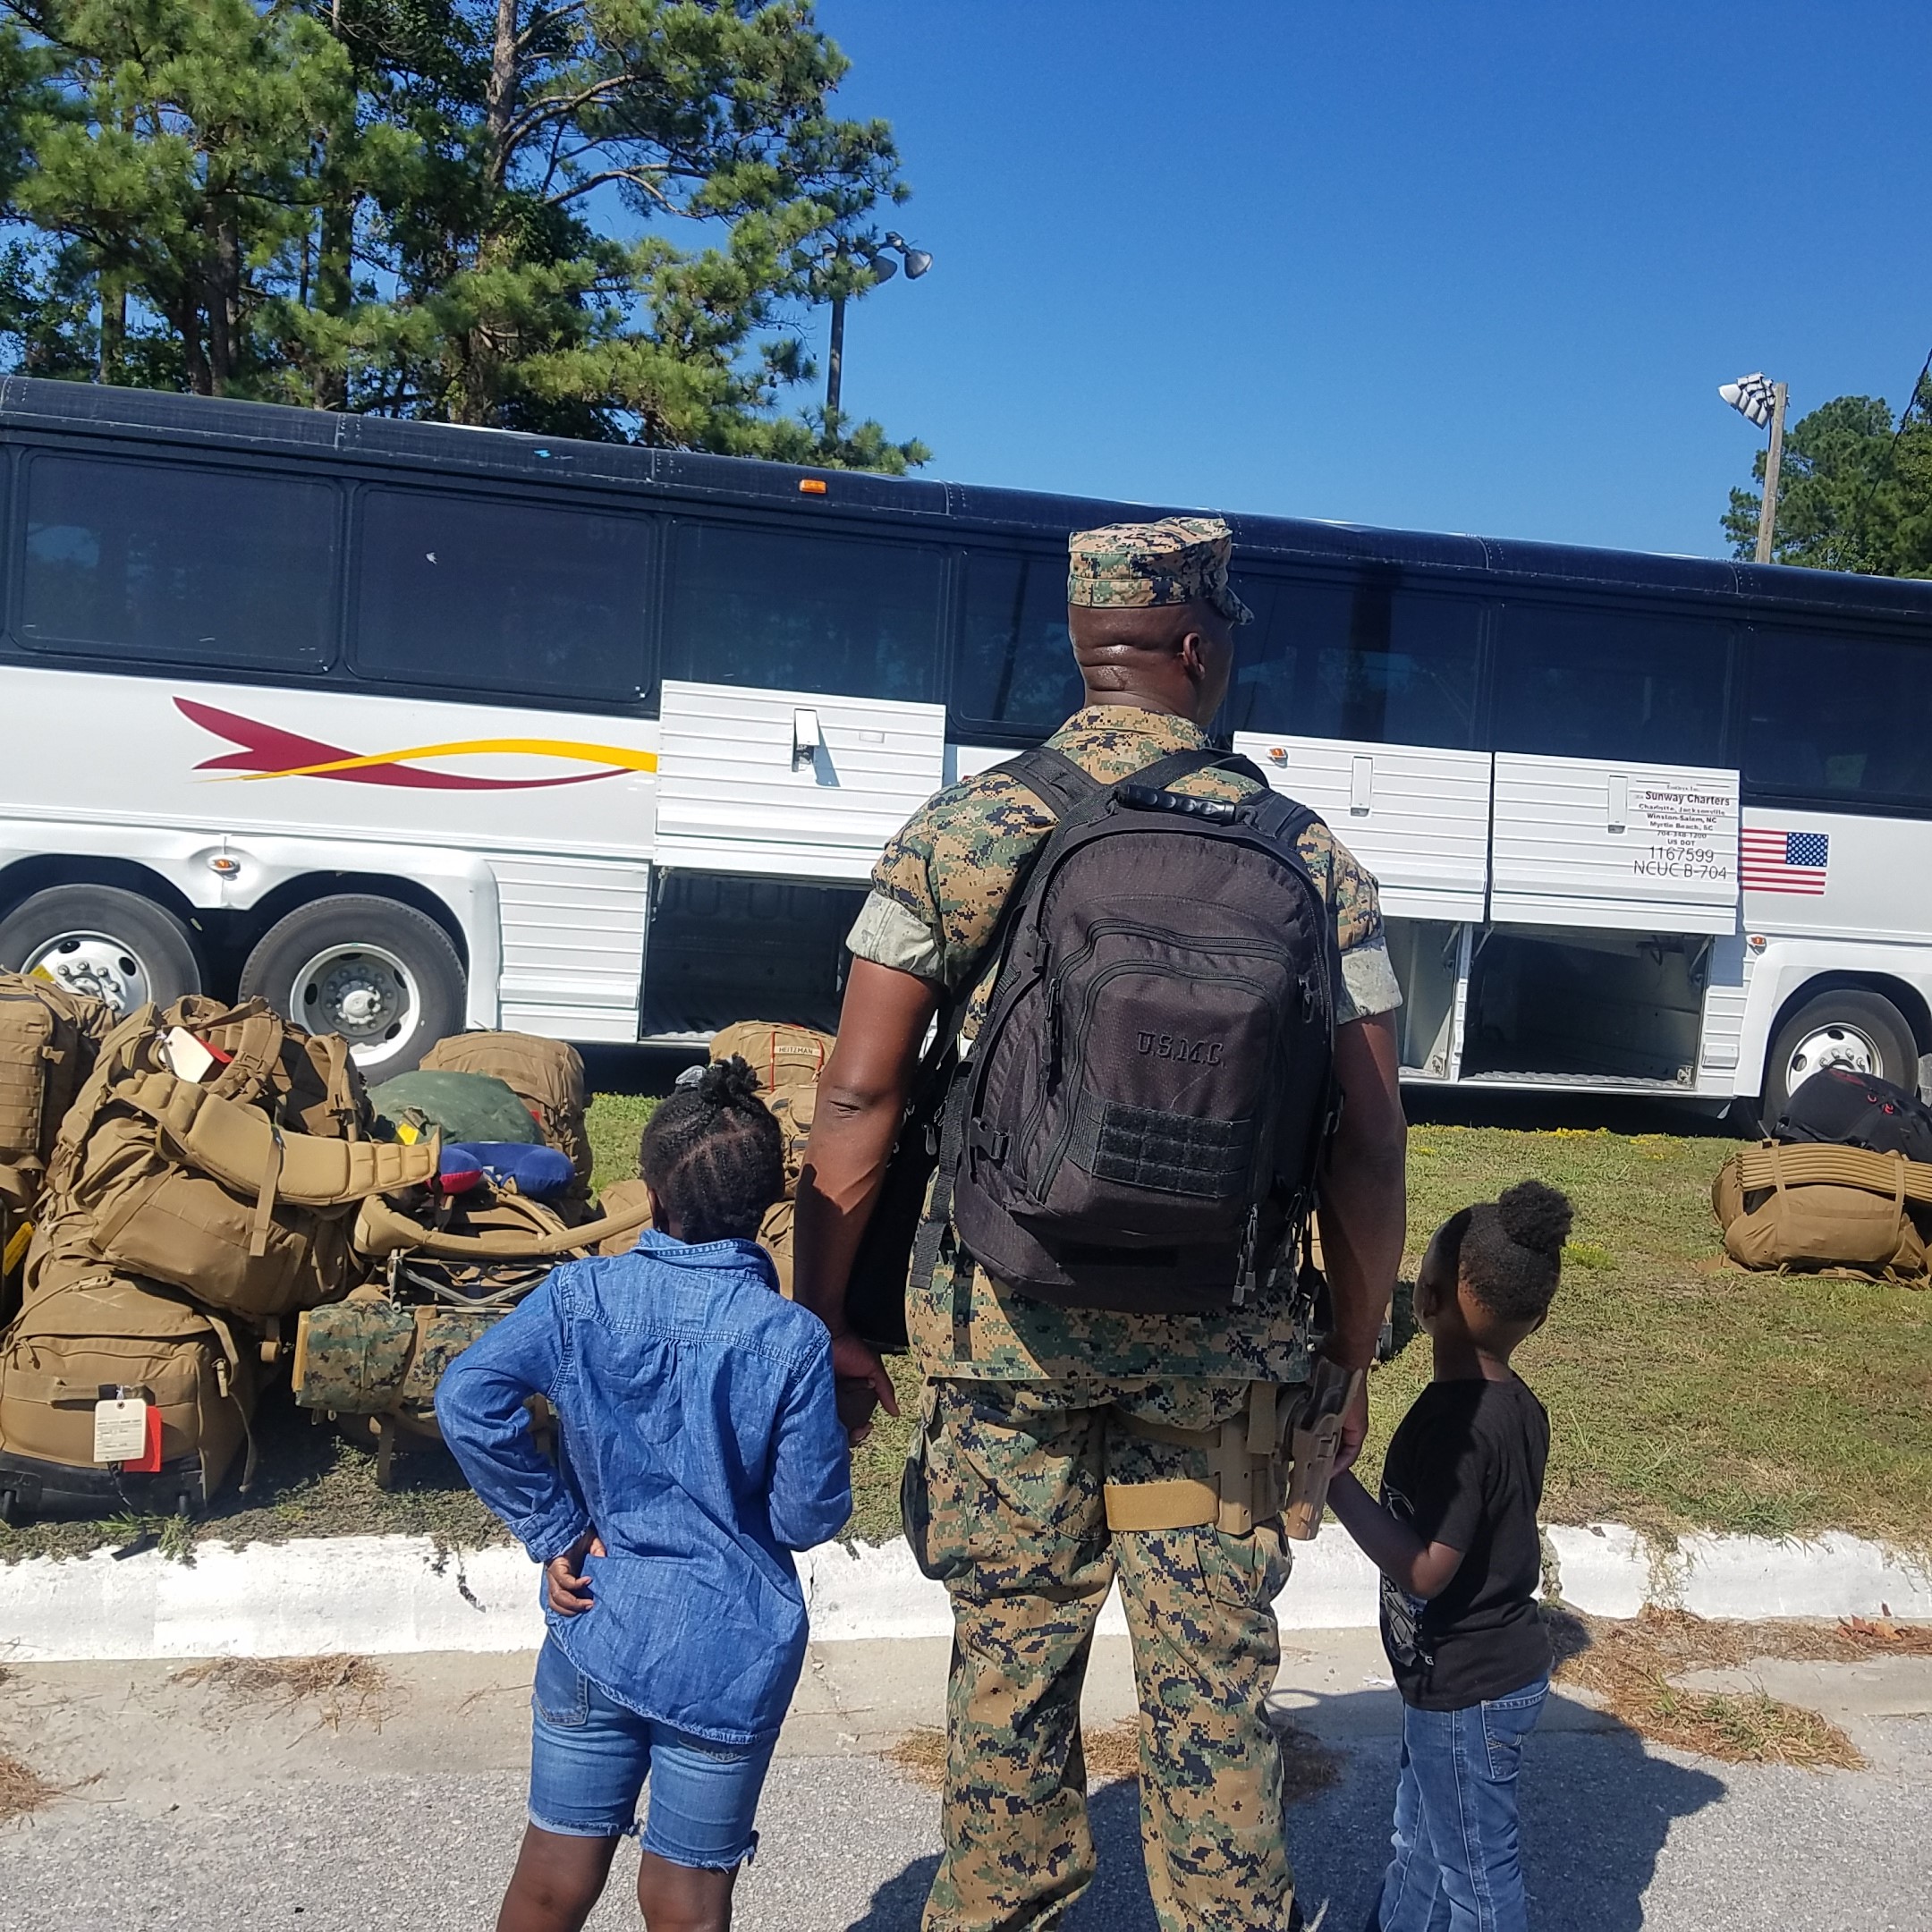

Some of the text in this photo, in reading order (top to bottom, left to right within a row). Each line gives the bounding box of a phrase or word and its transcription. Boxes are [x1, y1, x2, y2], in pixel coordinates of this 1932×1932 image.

[1645, 791, 1684, 804] Sunway
[1687, 793, 1730, 806] Charters
[1647, 812, 1705, 824] Winston-Salem,
[1679, 807, 1725, 816] Jacksonville
[1649, 845, 1714, 863] 1167599
[1633, 860, 1726, 879] NCUC B-704
